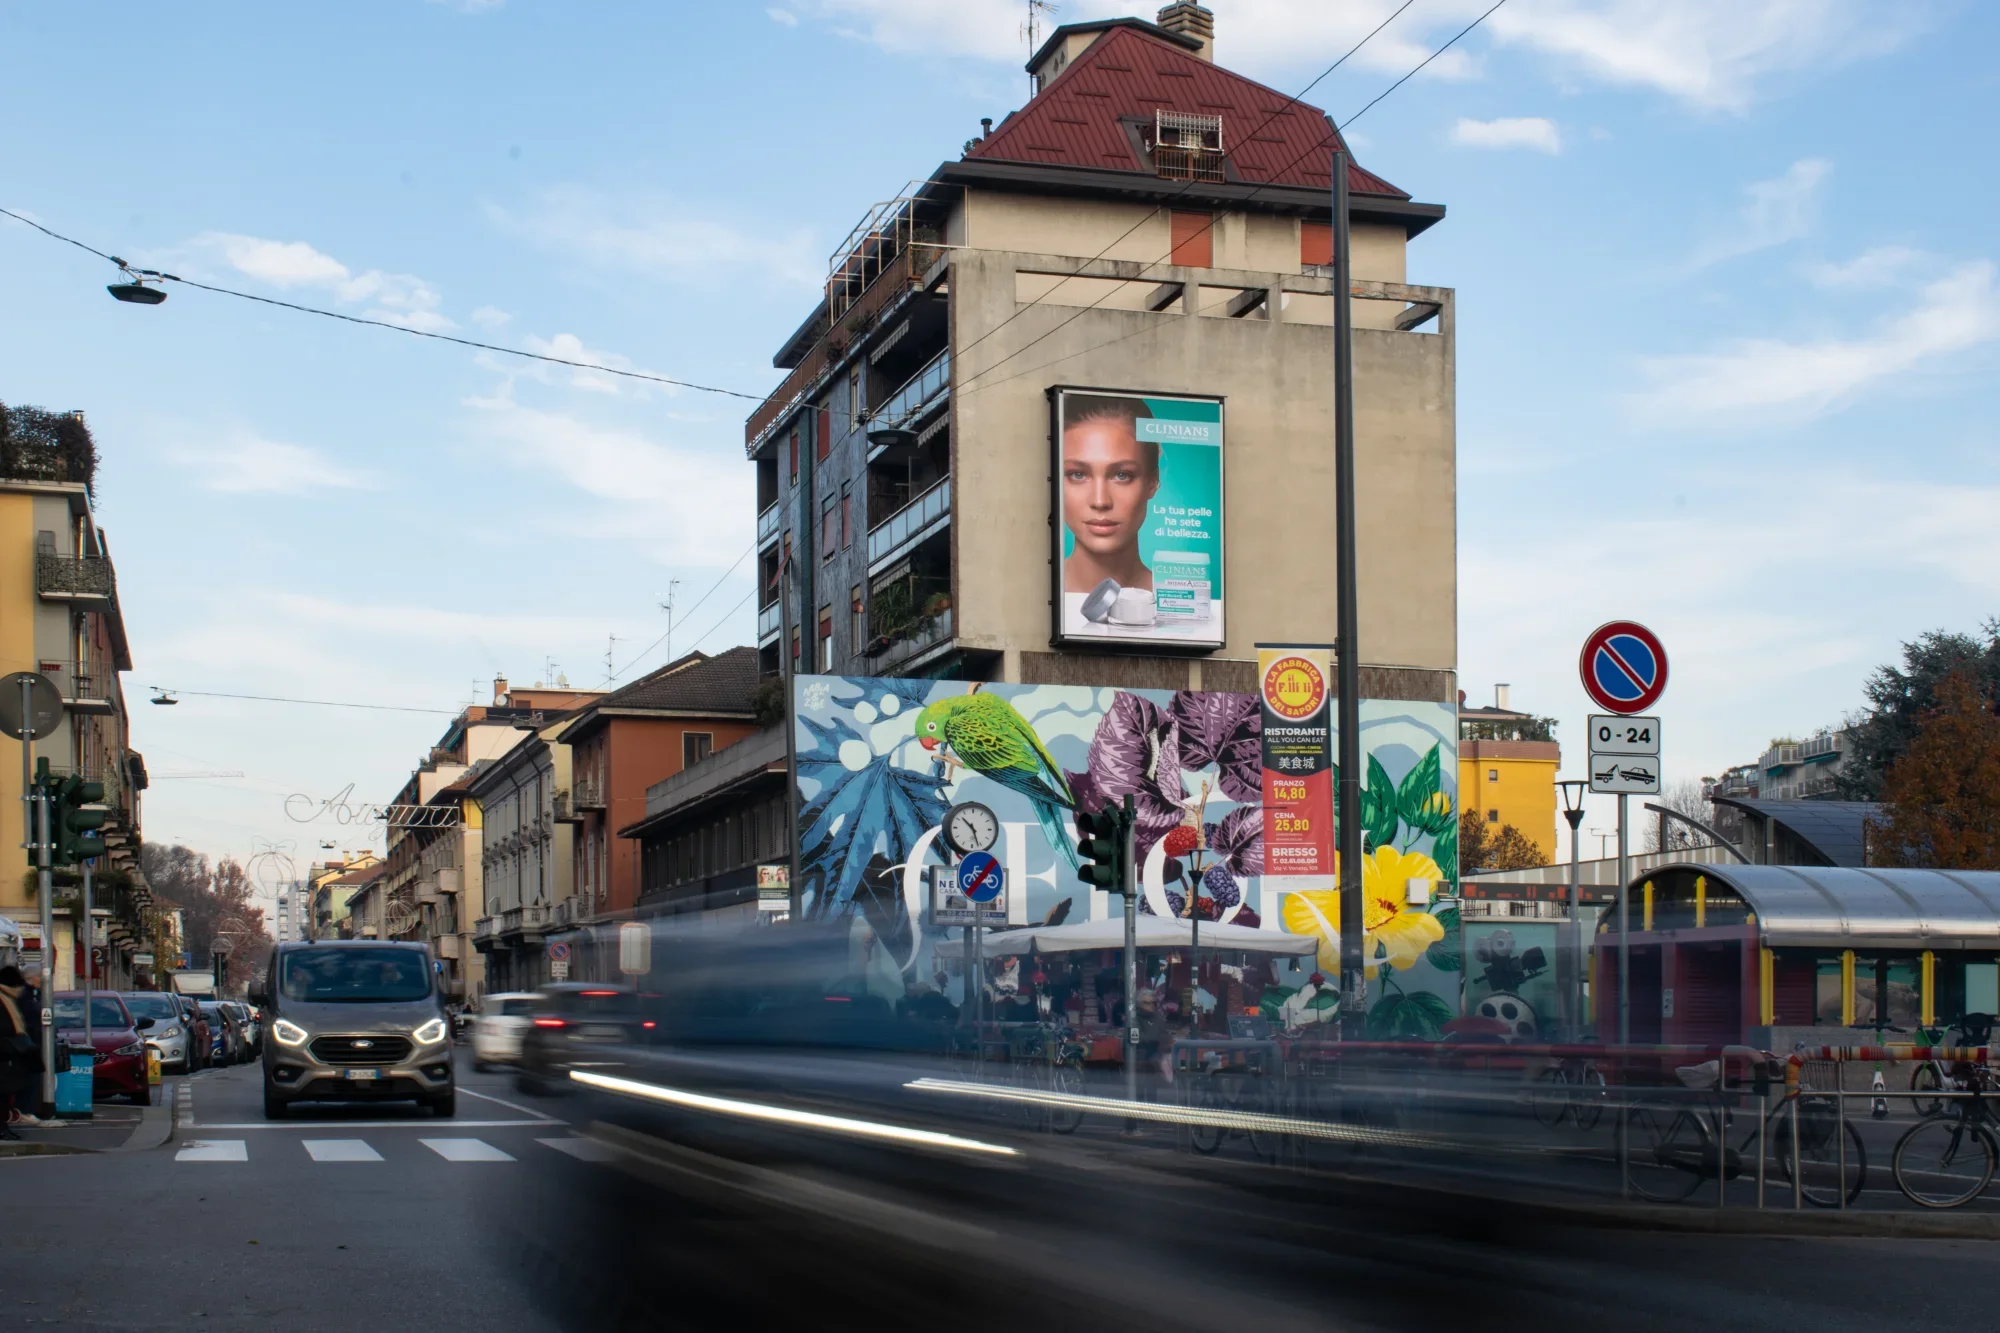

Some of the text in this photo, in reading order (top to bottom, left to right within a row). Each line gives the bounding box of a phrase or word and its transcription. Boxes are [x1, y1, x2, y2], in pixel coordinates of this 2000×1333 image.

[1145, 423, 1209, 437] CLINIANS
[1153, 504, 1212, 517] La tua pelle
[1164, 516, 1201, 527] ha sete
[1154, 528, 1211, 539] di bellezza.
[1155, 565, 1206, 575] CLINIANS
[1267, 659, 1321, 683] LA FABBRICA
[1270, 696, 1320, 716] DEI SAPORI
[1264, 727, 1327, 736] RISTORANTE
[1599, 726, 1611, 742] 0
[1626, 727, 1651, 743] 24
[1278, 756, 1315, 769] 美食城
[1273, 787, 1306, 801] 14,80
[1275, 819, 1310, 833] 25,80
[1272, 847, 1318, 857] BRESSO
